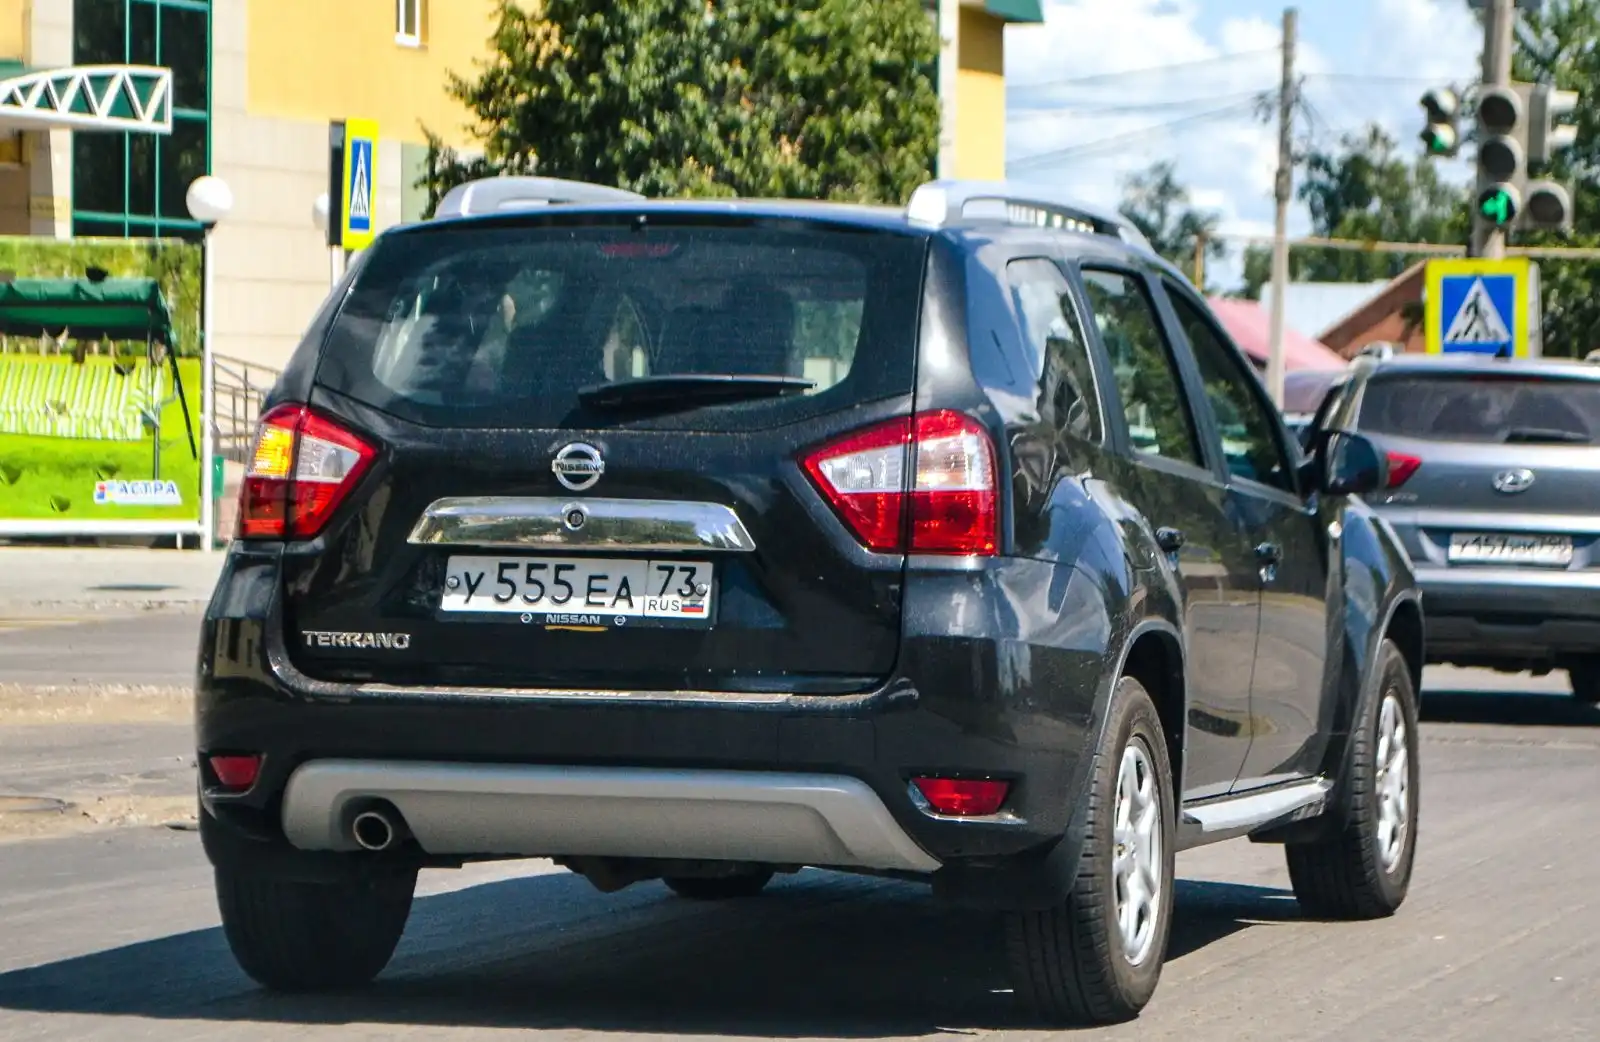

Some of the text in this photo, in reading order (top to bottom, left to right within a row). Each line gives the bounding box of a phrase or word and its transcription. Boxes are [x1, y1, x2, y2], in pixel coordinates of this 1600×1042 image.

[119, 482, 176, 494] АСТРА
[493, 562, 576, 605] 555
[656, 565, 698, 598] 73
[647, 600, 680, 612] RUS
[545, 613, 601, 625] NISSAN
[301, 630, 411, 650] TERRANO
